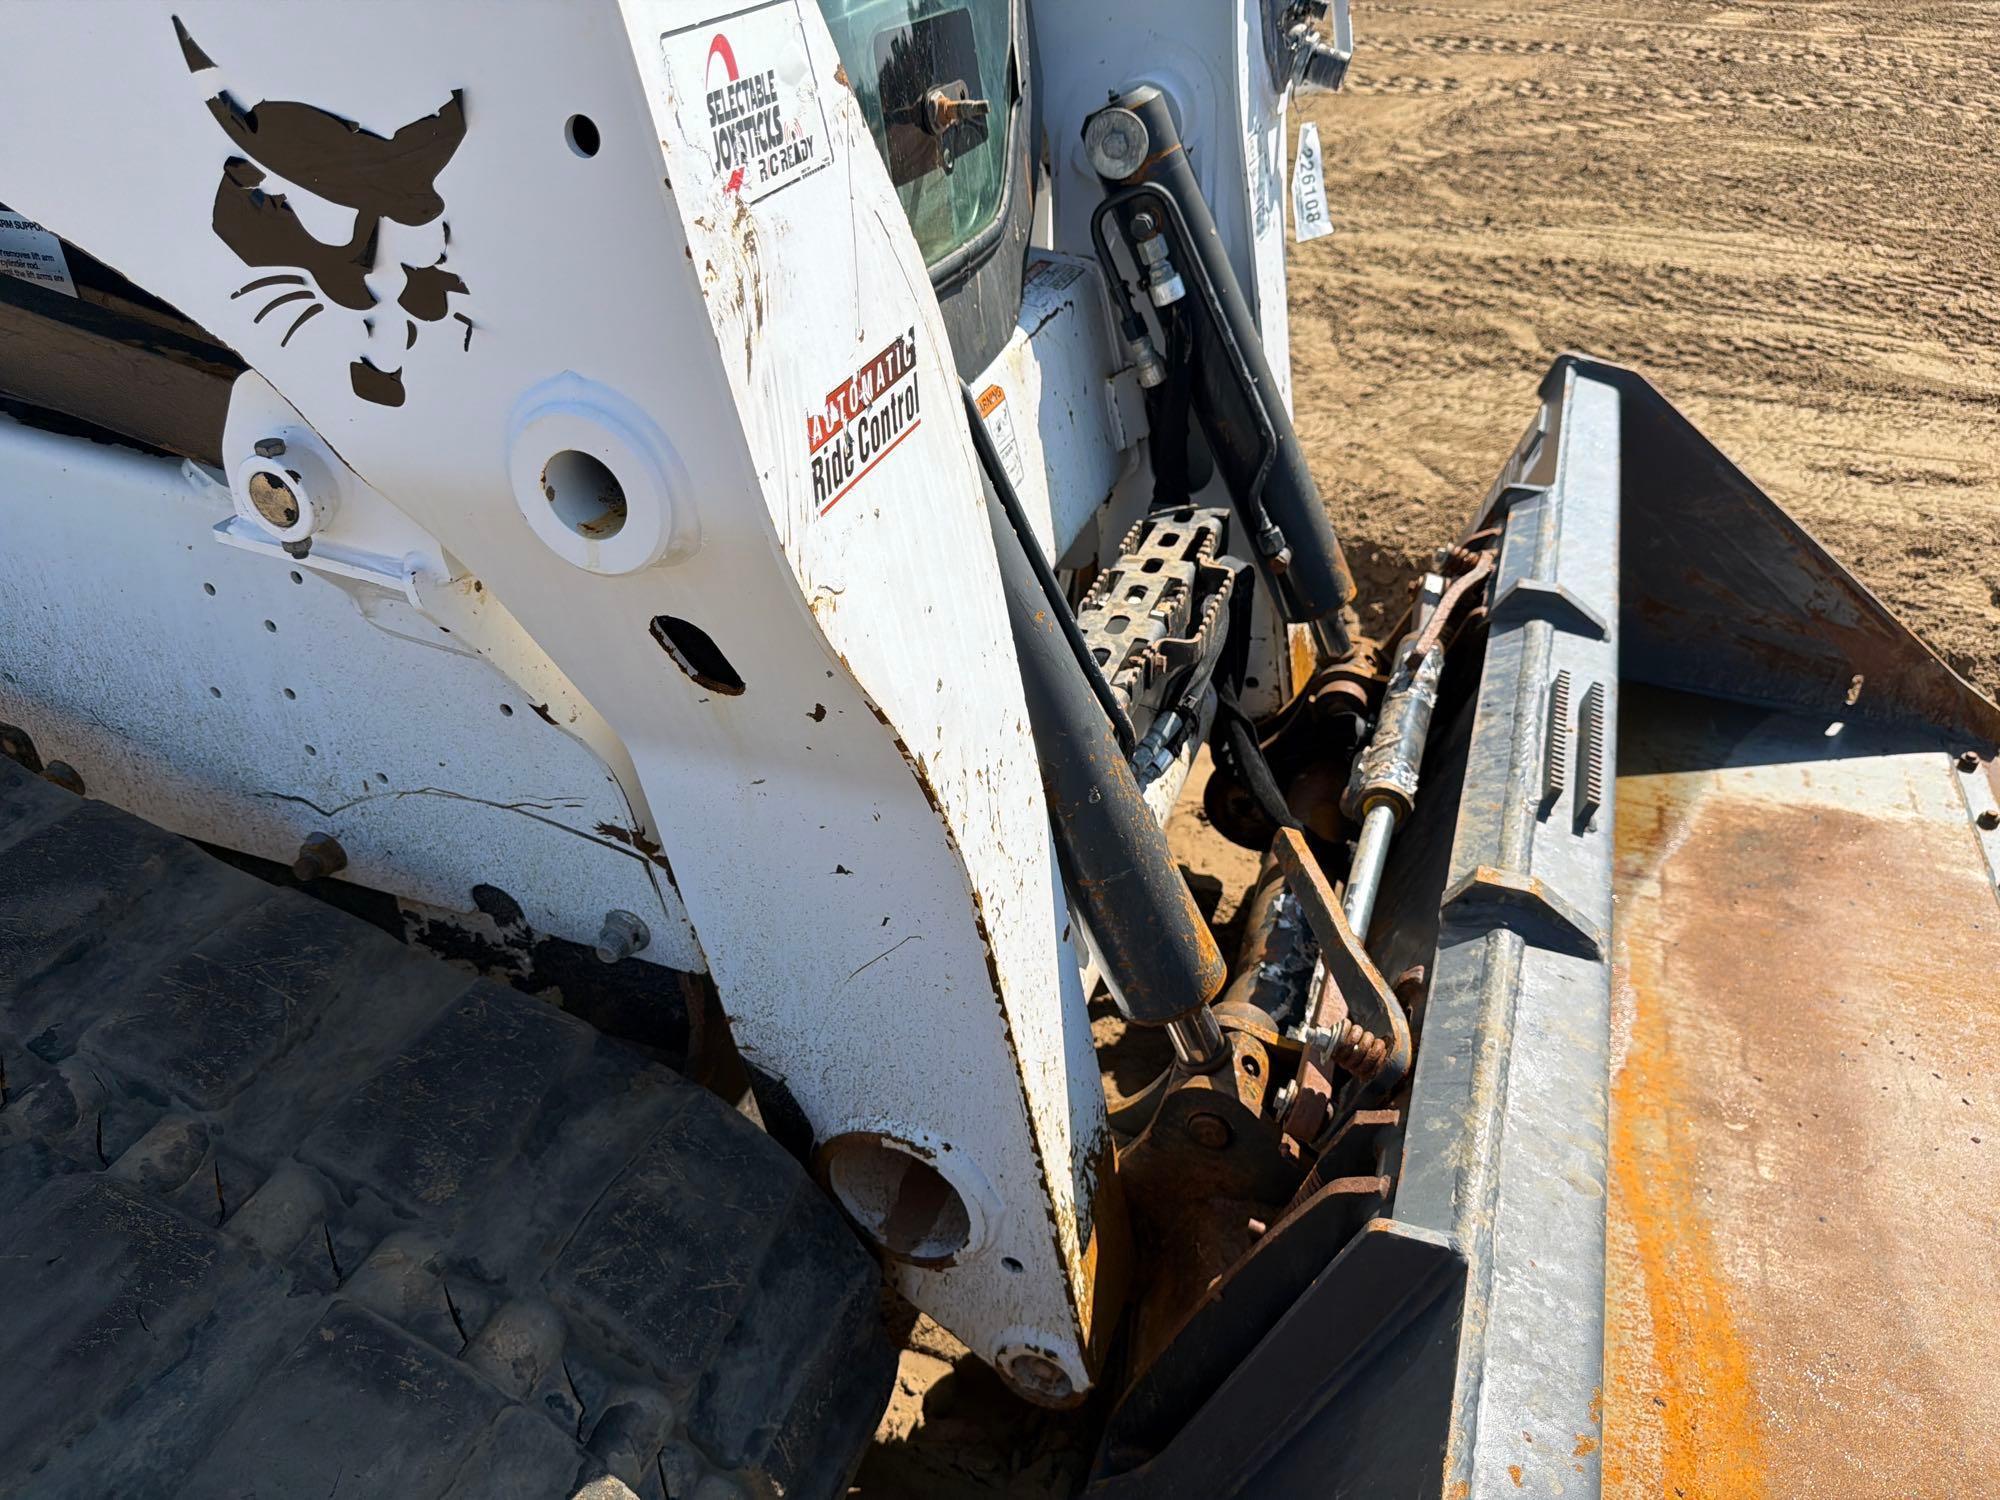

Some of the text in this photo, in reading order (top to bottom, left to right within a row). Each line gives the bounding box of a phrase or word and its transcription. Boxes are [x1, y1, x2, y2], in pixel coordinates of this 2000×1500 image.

[706, 69, 778, 128] SELECTABLE
[712, 104, 783, 174] JOYSTICKS
[780, 135, 813, 172] READY
[1300, 147, 1321, 223] 226108
[812, 340, 914, 447] AUTOMATIC
[811, 371, 919, 508] Ride Control
